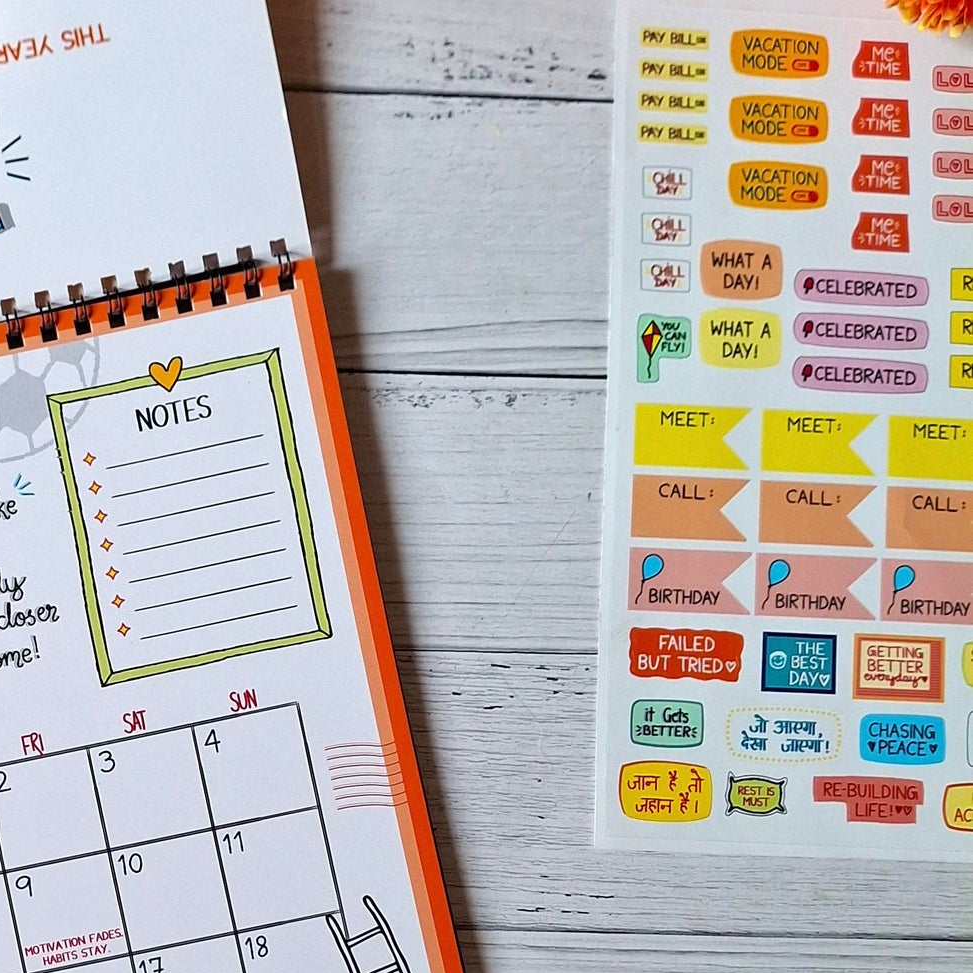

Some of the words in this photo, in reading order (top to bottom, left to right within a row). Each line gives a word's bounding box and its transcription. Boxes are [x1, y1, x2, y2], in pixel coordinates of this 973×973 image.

[61, 23, 110, 50] THIS
[643, 30, 665, 44] PAY
[670, 32, 696, 46] BILL
[743, 35, 820, 55] VACATION
[742, 54, 787, 71] MODE
[866, 61, 901, 76] TIME
[711, 251, 754, 270] WHAT
[761, 255, 772, 270] A
[723, 273, 760, 291] DAY!
[815, 279, 918, 299] CELEBRATED
[661, 321, 681, 331] YOU
[664, 332, 686, 341] CAN
[135, 394, 212, 432] NOTES
[660, 410, 715, 428] MEET:
[648, 588, 721, 606] BIRTHDAY
[658, 634, 716, 652] FAILED
[796, 641, 826, 656] THE
[867, 645, 924, 659] GETTING
[637, 653, 671, 671] BUT
[677, 656, 723, 674] TRIED
[791, 656, 828, 671] BEST
[867, 658, 924, 674] BETTER
[788, 670, 819, 686] DAY
[863, 672, 922, 688] everyday
[21, 732, 45, 756] FRI
[122, 710, 147, 734] SAT
[229, 689, 258, 712] SUN
[642, 724, 692, 738] BETTER
[749, 714, 769, 735] जो
[868, 722, 936, 740] CHASING
[878, 741, 926, 756] PEACE
[627, 775, 662, 791] जान
[668, 770, 678, 792] है
[688, 768, 705, 794] तो
[737, 785, 764, 796] REST
[766, 786, 775, 796] IS
[823, 781, 918, 800] RE-BUILDING
[635, 797, 674, 814] जहान
[742, 796, 770, 807] MUST
[855, 803, 893, 818] LIFE!
[117, 852, 143, 876] 10
[24, 935, 86, 957] MOTIVATION
[42, 950, 78, 966] HABITS
